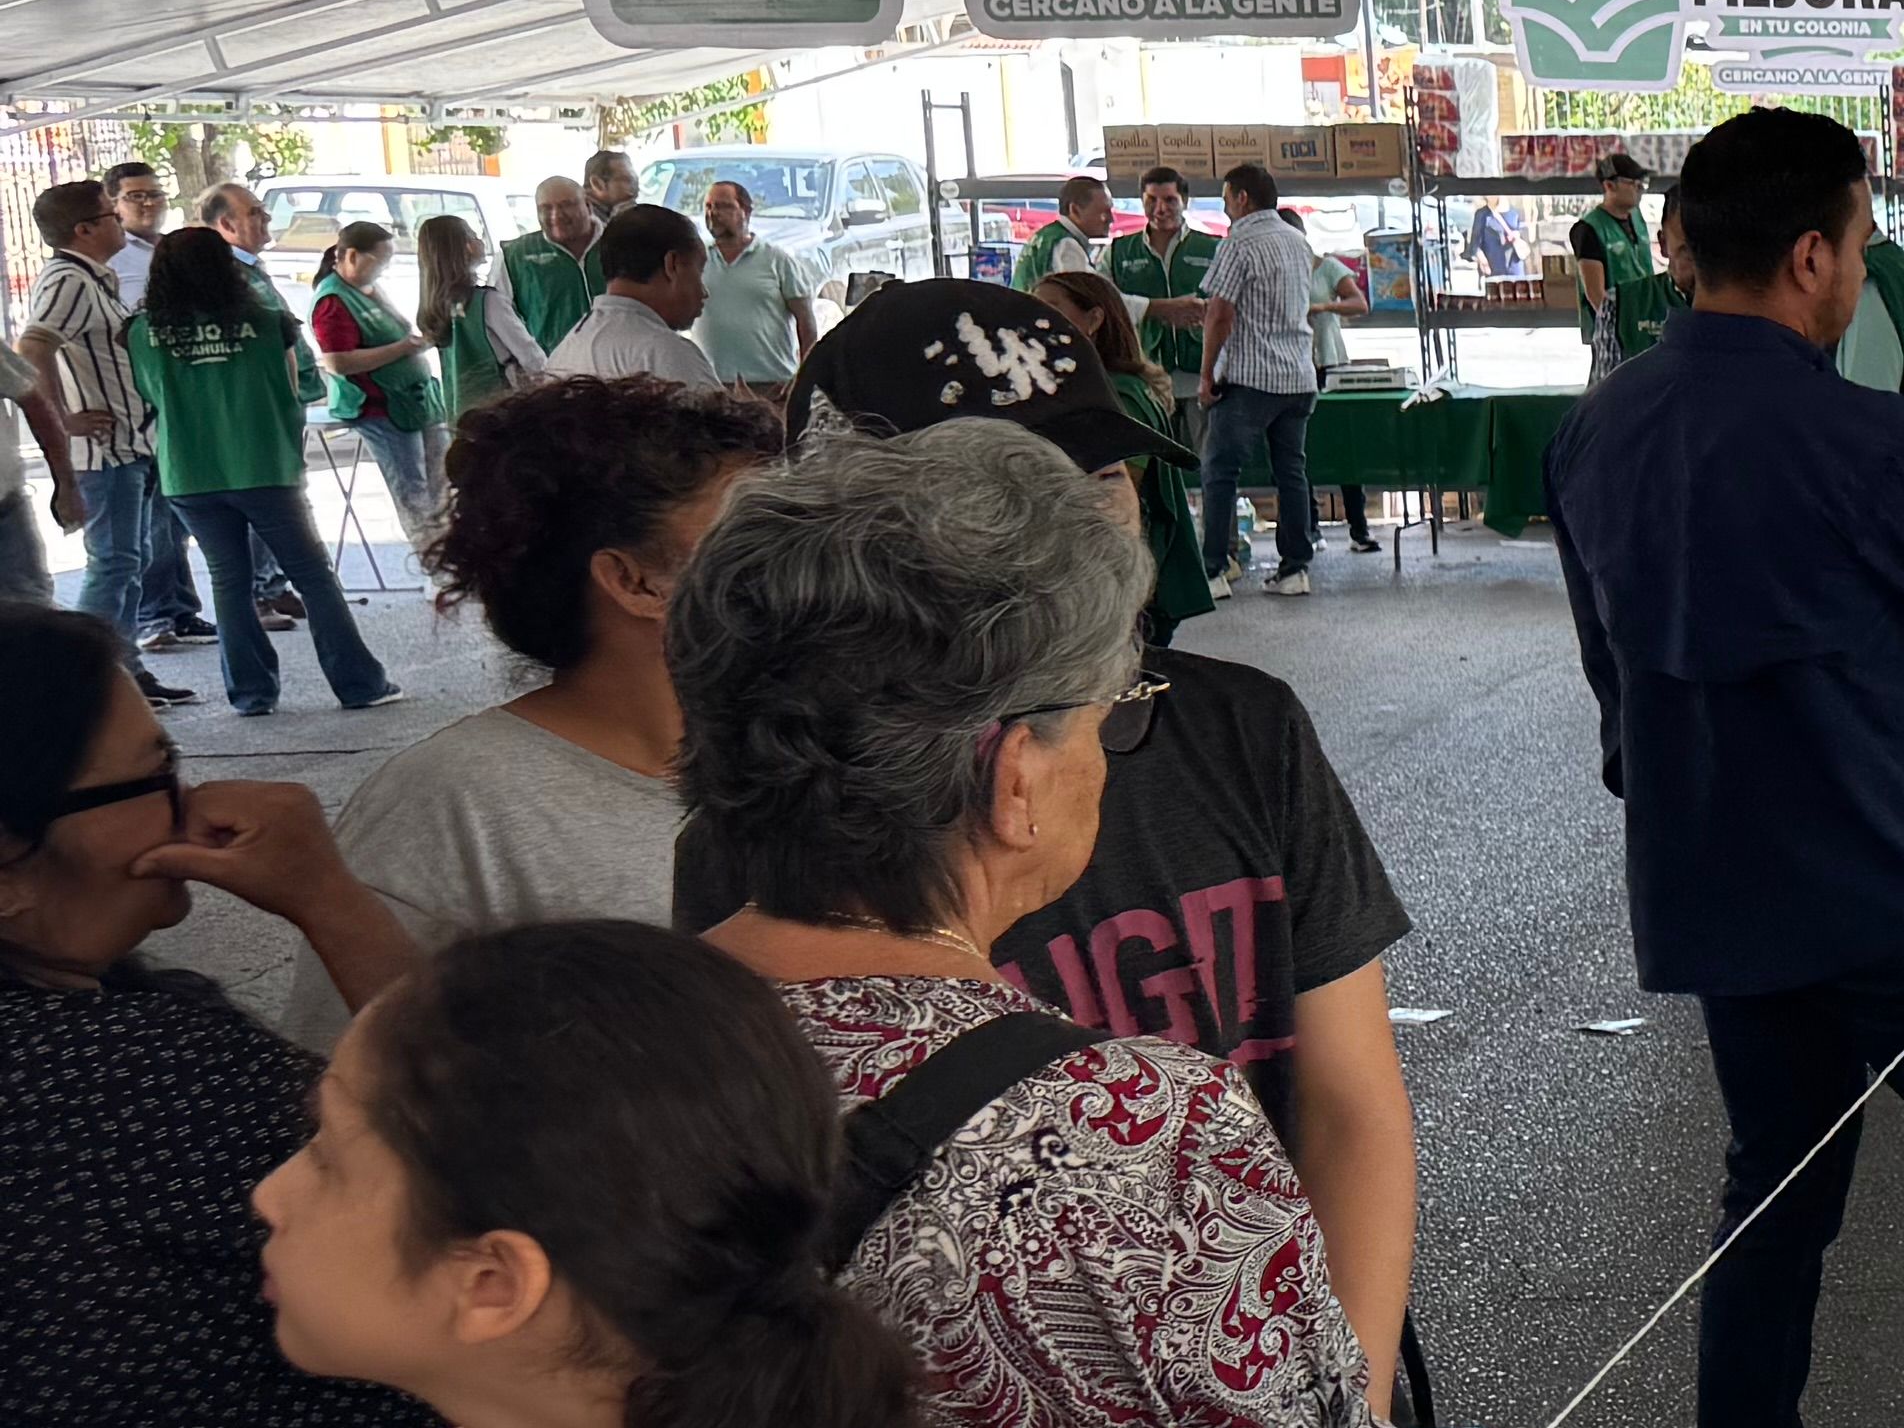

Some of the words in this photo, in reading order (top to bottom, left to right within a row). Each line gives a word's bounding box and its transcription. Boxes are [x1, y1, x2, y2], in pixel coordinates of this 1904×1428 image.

[1739, 19, 1763, 35] EN
[1765, 19, 1791, 35] TU
[1793, 20, 1872, 36] COLONIA
[1721, 68, 1800, 85] CERCANO
